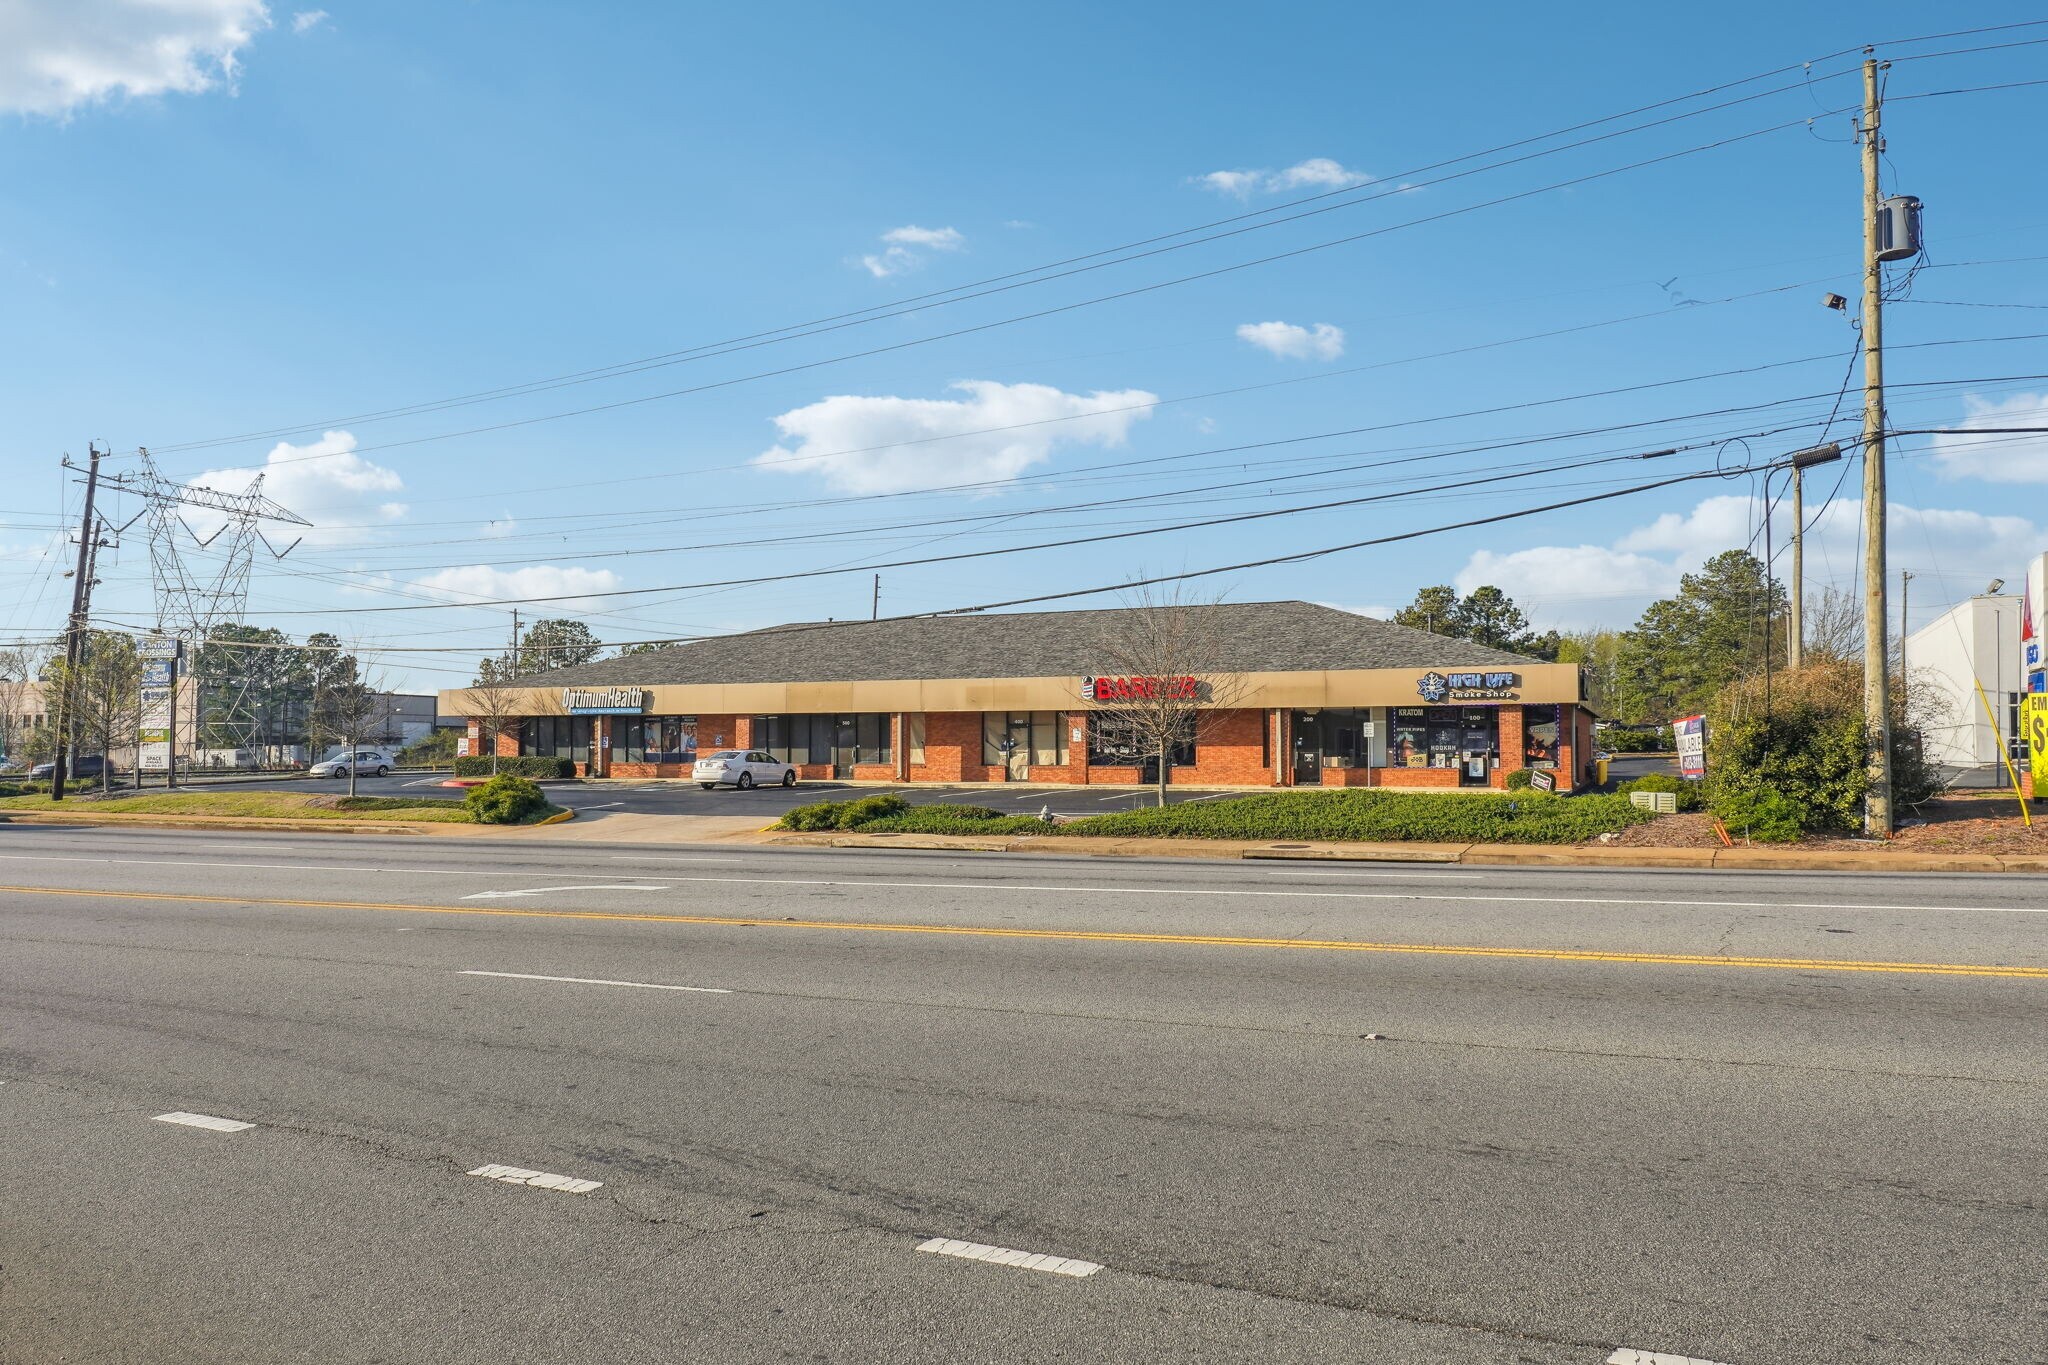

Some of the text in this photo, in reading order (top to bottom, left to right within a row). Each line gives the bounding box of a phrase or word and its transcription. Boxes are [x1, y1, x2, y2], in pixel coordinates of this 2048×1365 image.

[1448, 673, 1513, 688] HIGH LYFE
[562, 687, 643, 712] OptimumHealth
[1486, 690, 1512, 698] Shop
